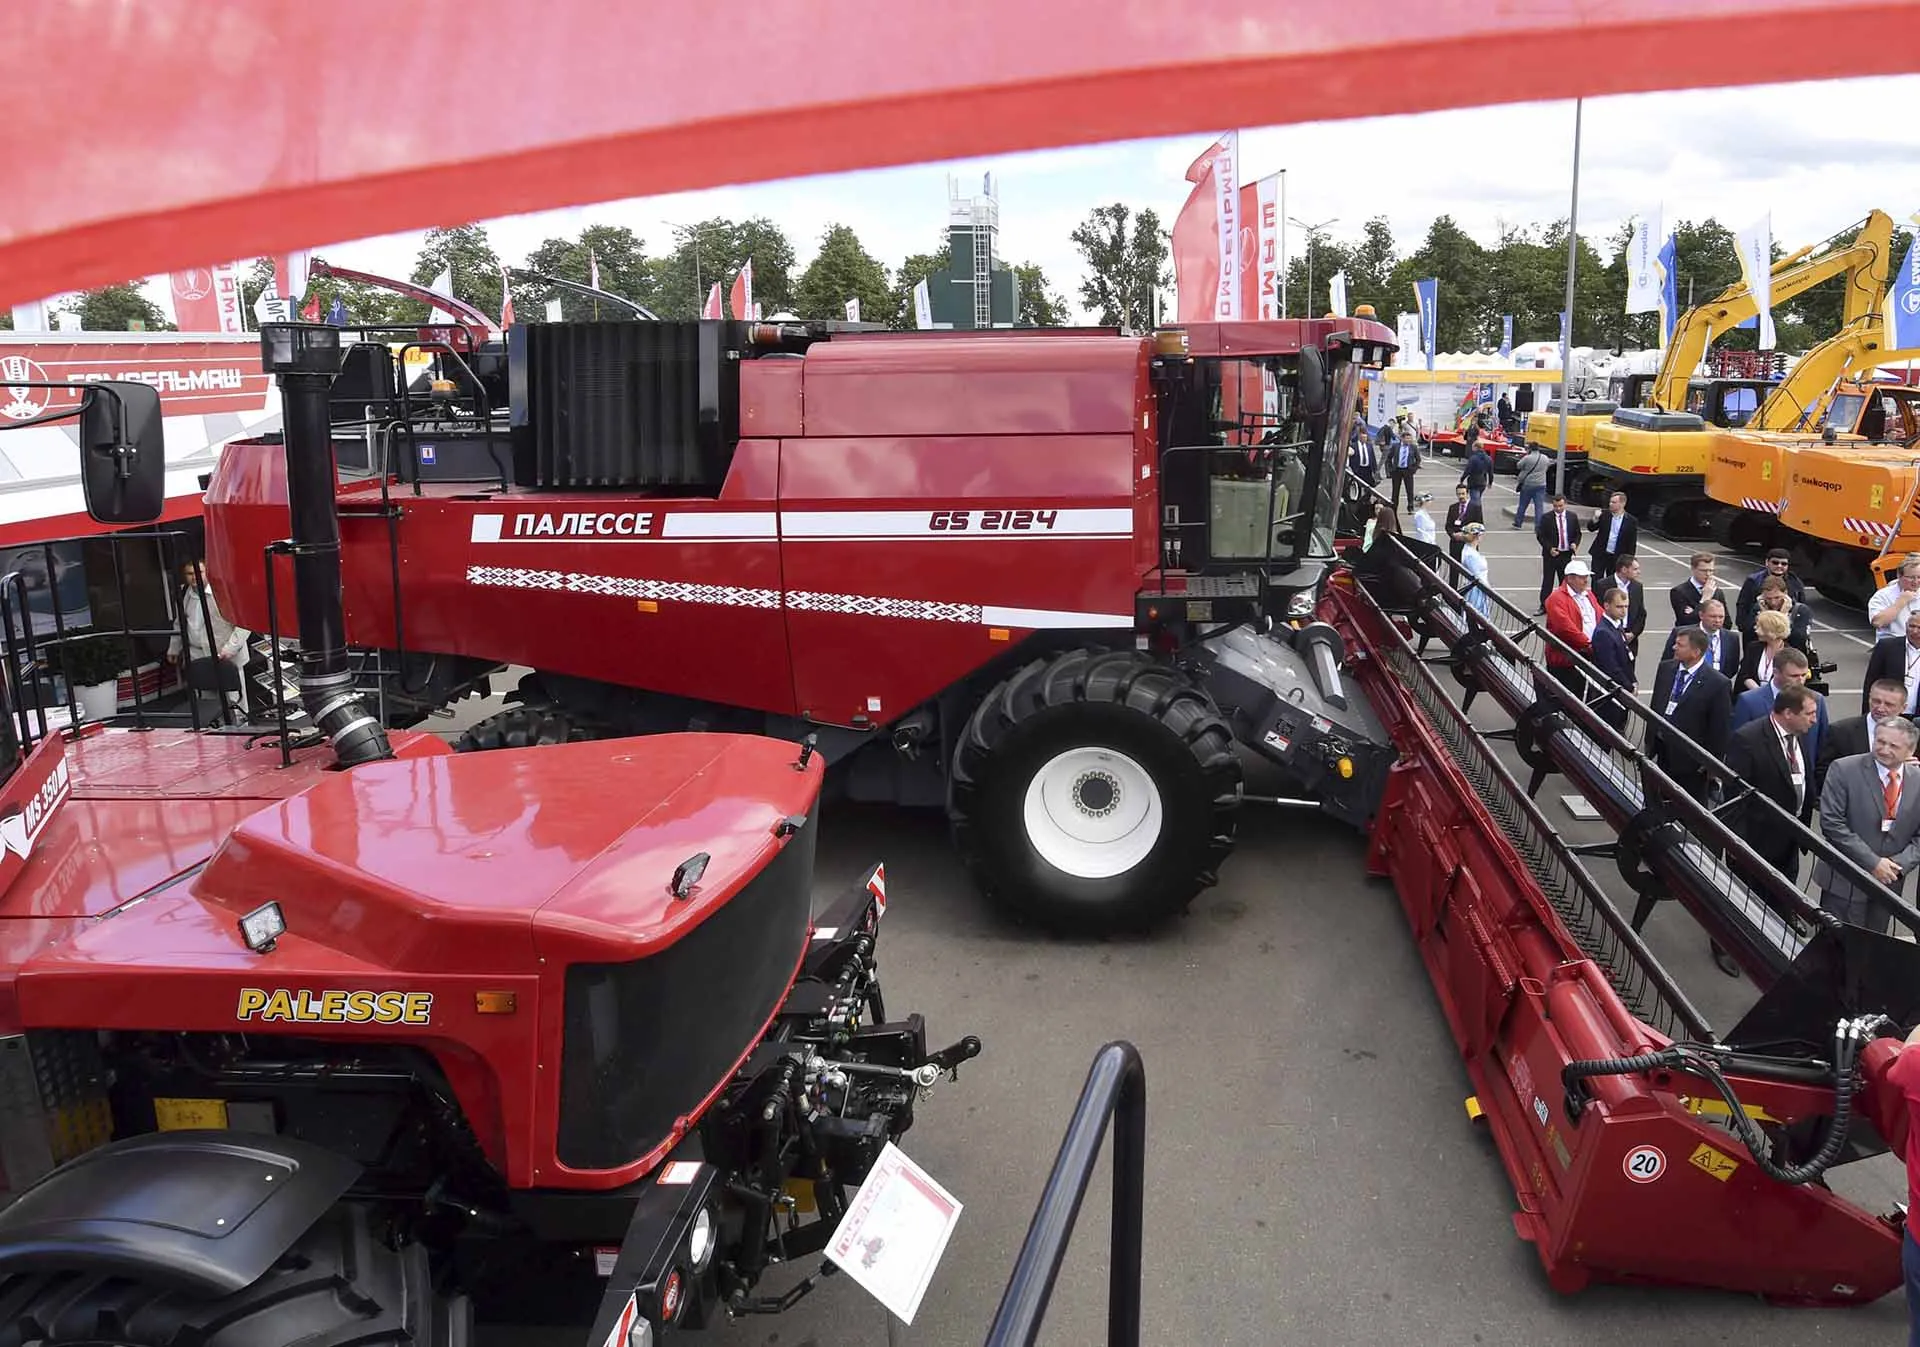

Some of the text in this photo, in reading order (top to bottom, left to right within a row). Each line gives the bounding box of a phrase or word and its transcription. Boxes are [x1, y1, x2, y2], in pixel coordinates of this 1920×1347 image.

[513, 512, 653, 536] ПАЛЕССЕ
[929, 510, 1058, 531] GS 2124
[25, 769, 59, 834] MS 350
[236, 988, 433, 1024] PALESSE
[1631, 1153, 1658, 1174] 20
